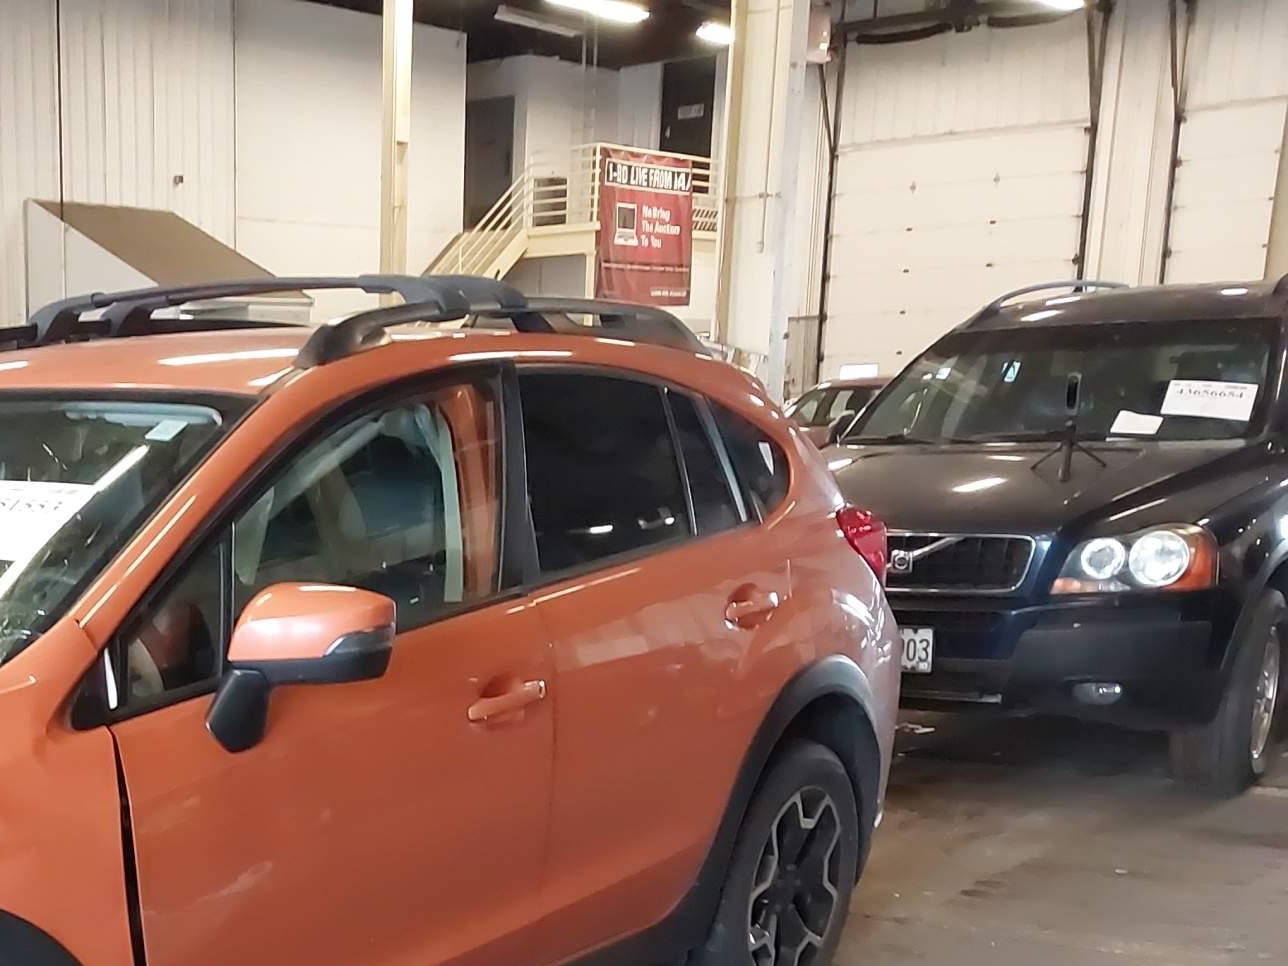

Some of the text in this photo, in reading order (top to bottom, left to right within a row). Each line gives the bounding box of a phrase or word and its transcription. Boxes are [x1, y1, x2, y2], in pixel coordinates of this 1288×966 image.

[630, 165, 648, 187] LIVE
[649, 167, 672, 190] FROM
[653, 206, 671, 222] Bring
[642, 220, 681, 236] The Auction
[641, 234, 662, 248] To You
